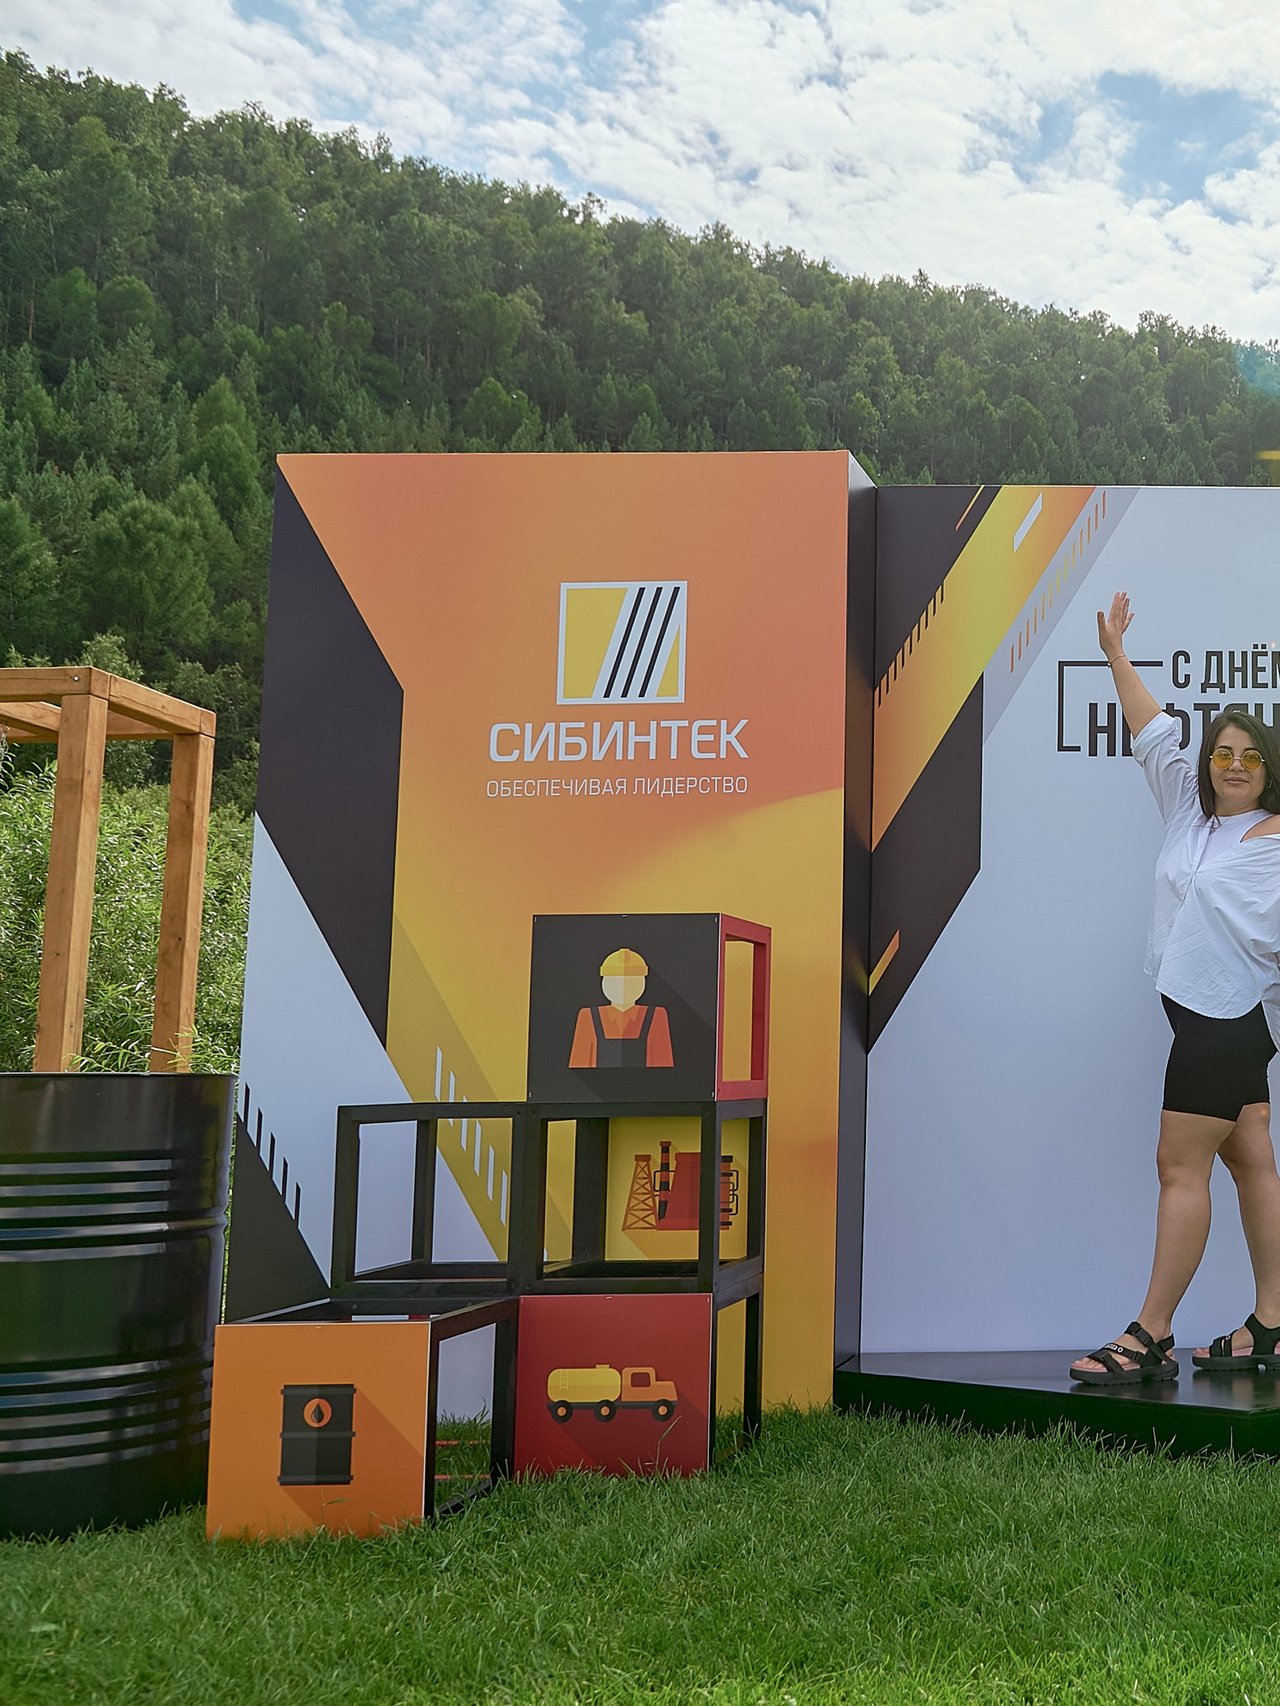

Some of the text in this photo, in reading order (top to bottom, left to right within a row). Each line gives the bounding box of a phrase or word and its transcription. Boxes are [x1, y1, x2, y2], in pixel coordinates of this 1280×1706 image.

[1172, 650, 1191, 689] С
[489, 719, 749, 762] СИБИНТЕК
[486, 776, 748, 797] ОБЕСПЕЧИВАЯ ЛИДЕРСТВО
